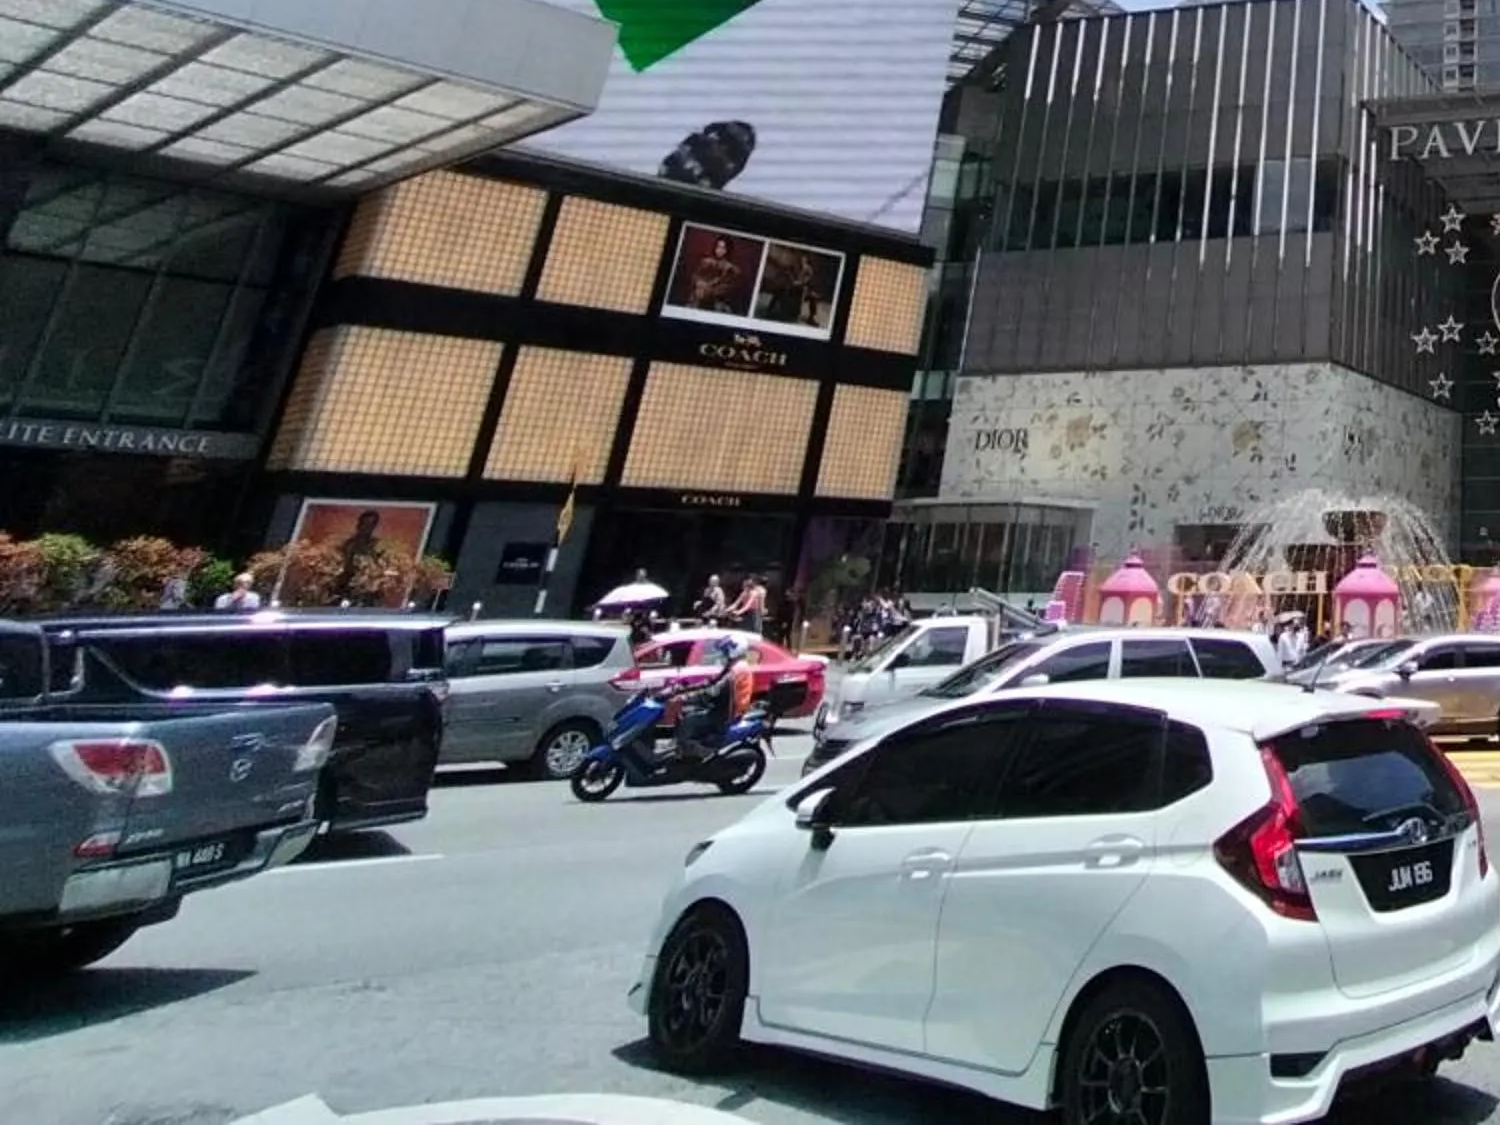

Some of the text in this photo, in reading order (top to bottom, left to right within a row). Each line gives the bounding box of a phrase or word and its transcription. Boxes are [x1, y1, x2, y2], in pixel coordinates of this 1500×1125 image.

[699, 343, 787, 366] COACH
[62, 427, 213, 453] ENTRANCE
[974, 428, 1029, 452] DIOR
[1167, 571, 1328, 595] COACH
